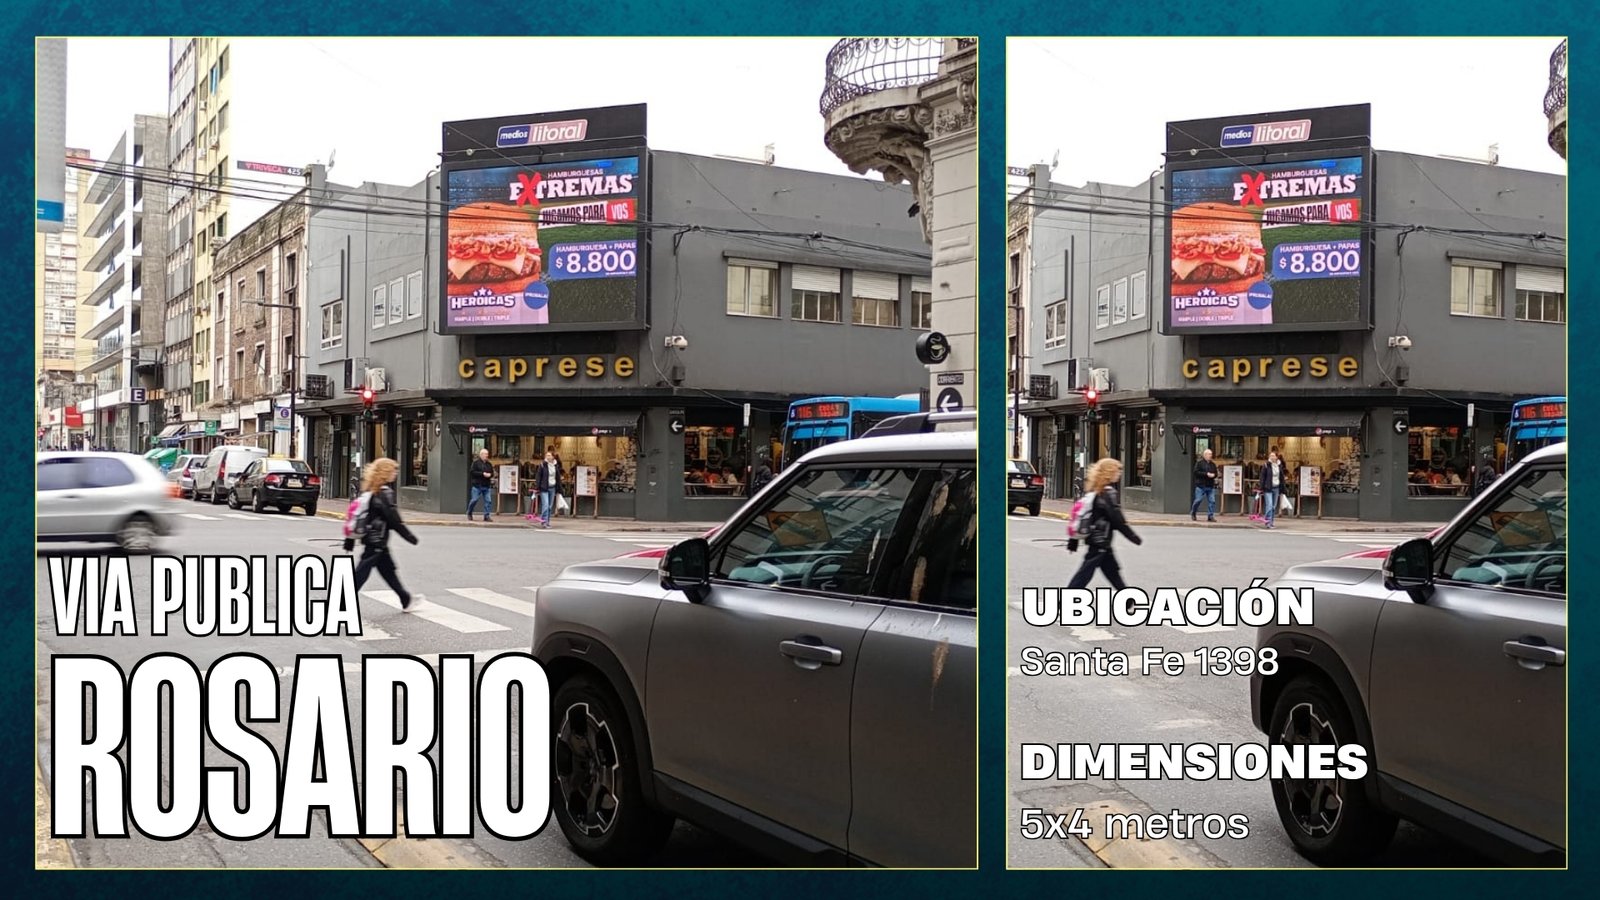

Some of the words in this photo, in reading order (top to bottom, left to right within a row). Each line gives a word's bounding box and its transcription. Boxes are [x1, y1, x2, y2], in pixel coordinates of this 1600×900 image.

[499, 130, 528, 140] medios
[532, 123, 583, 142] litoral
[1224, 130, 1252, 140] medios
[1256, 123, 1306, 142] litoral
[548, 168, 603, 178] HAMBURGUESAS
[1271, 168, 1327, 178] HAMBURGUESAS
[509, 172, 632, 207] EXTREMAS
[1233, 172, 1356, 207] EXTREMAS
[583, 203, 606, 222] PARA
[611, 202, 629, 220] VOS
[1307, 203, 1330, 222] PARA
[1335, 202, 1353, 220] VOS
[556, 244, 608, 253] HAMBURGUESA
[614, 242, 636, 250] PAPAS
[1280, 244, 1332, 253] HAMBURGUESA
[1338, 242, 1360, 250] PAPAS
[566, 250, 636, 274] 8.800
[1290, 250, 1360, 274] 8.800
[451, 295, 515, 310] HEROICAS
[1175, 295, 1239, 310] HEROICAS
[458, 356, 634, 384] caprese
[1182, 356, 1359, 384] caprese
[134, 389, 143, 401] E
